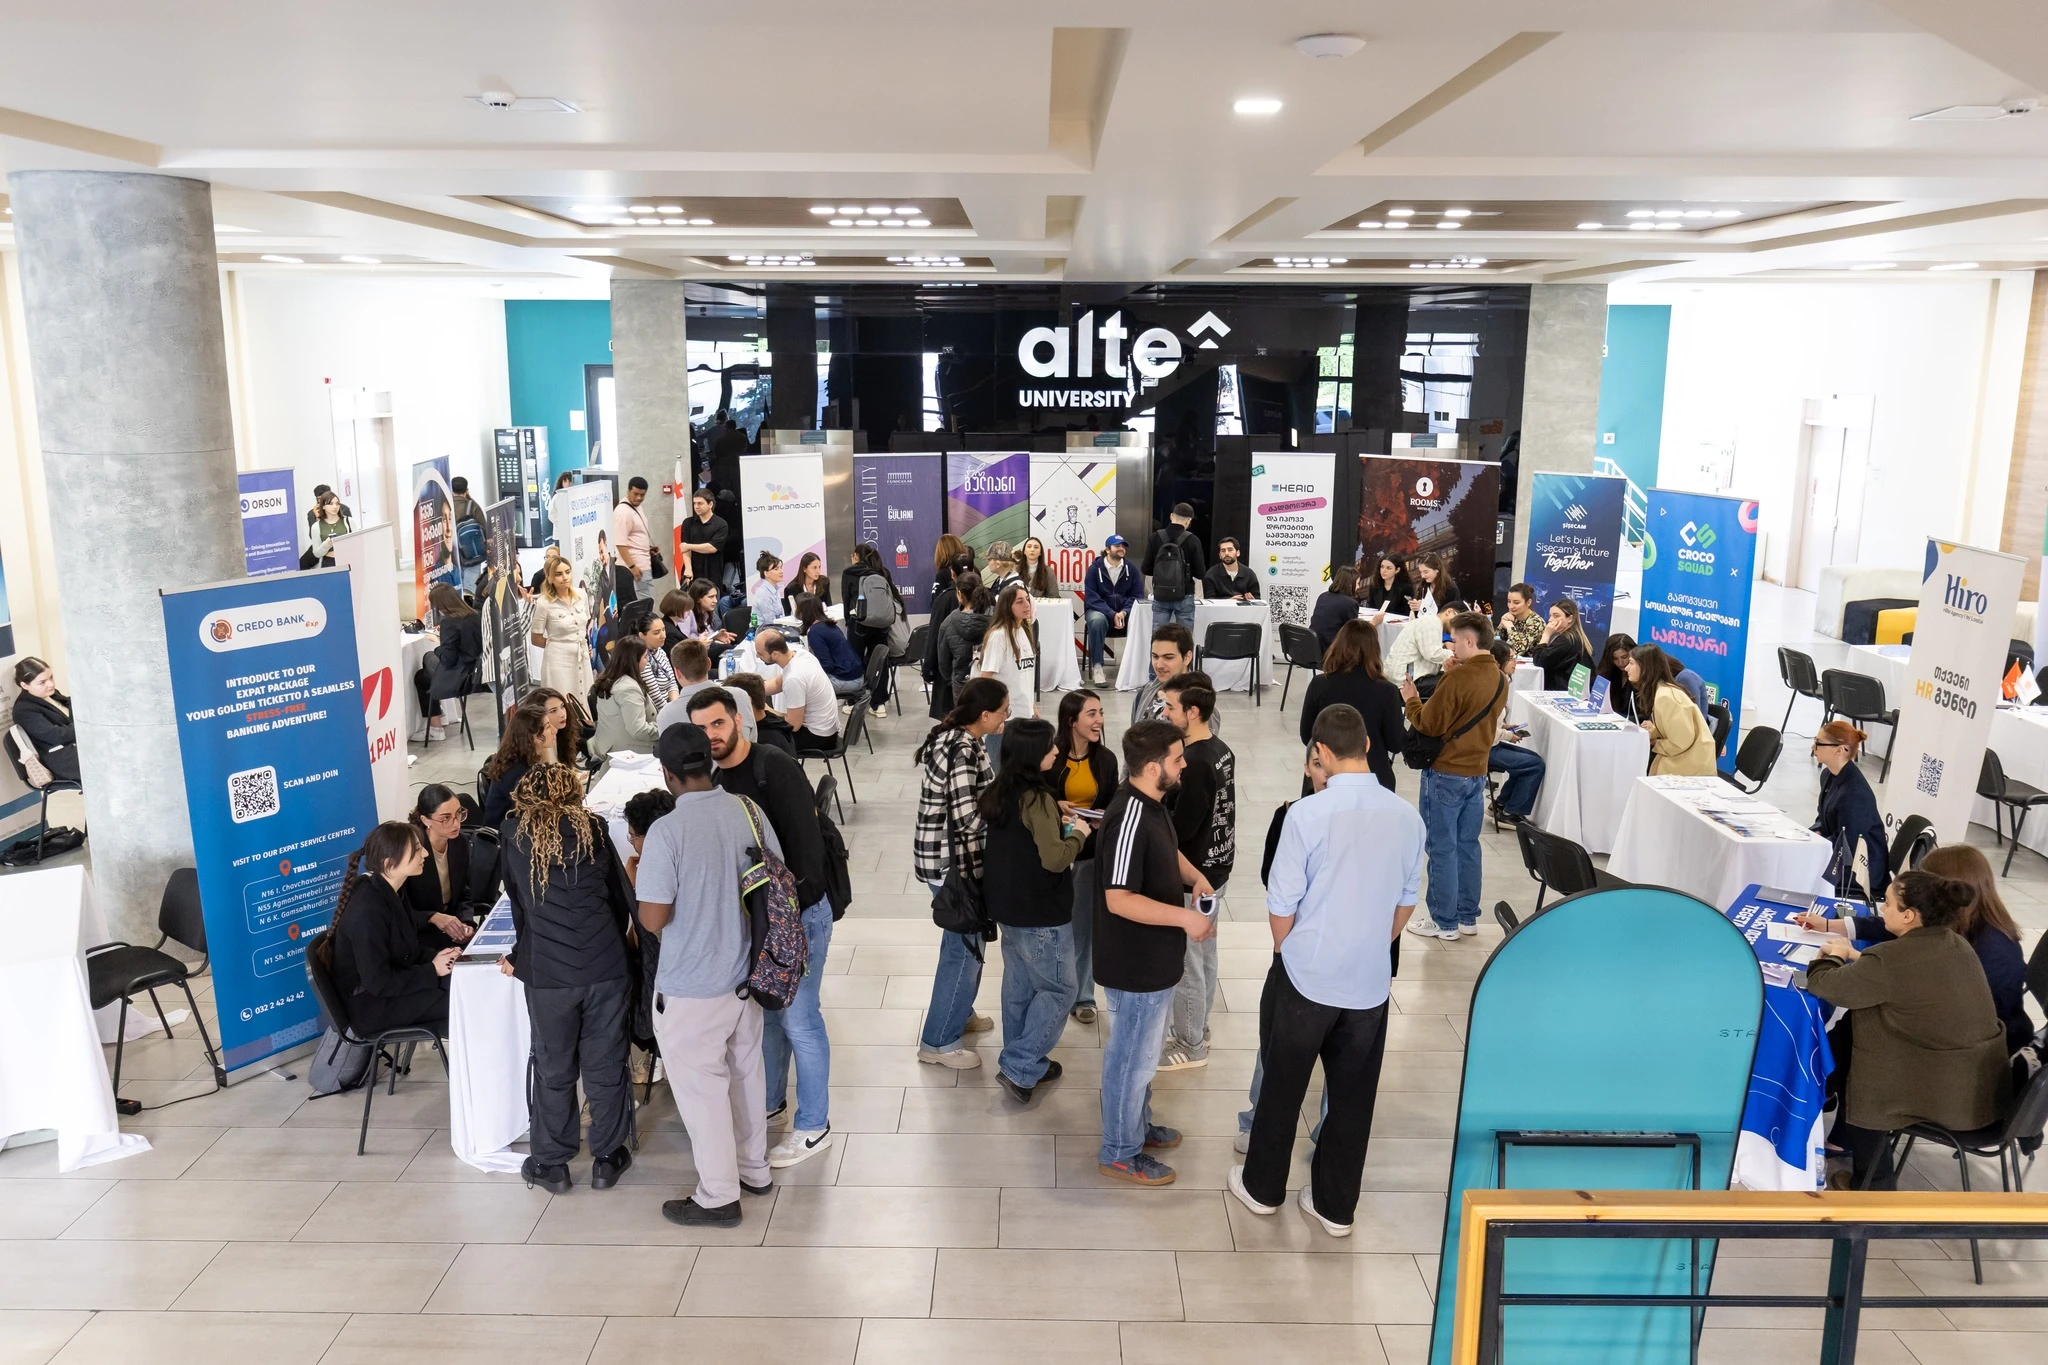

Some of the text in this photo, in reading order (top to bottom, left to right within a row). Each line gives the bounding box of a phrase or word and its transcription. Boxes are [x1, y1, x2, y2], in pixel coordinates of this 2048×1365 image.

[1018, 310, 1182, 378] alte
[1019, 390, 1136, 408] UNIVERSITY
[964, 476, 1016, 492] გულიანი
[1279, 484, 1315, 493] HERIO
[252, 497, 282, 510] ORSON
[861, 465, 879, 551] OSPITALITY
[1268, 500, 1317, 512] გადმოწერე
[1410, 497, 1438, 507] ROOMS
[888, 510, 914, 520] GULIANI
[1265, 532, 1315, 540] სამუშაოები
[1266, 523, 1314, 531] დროებითი
[1549, 533, 1597, 546] Let's build
[1581, 546, 1610, 558] future
[1677, 548, 1715, 563] CROCO
[1541, 551, 1594, 573] Together
[1677, 560, 1714, 576] SQUAD
[1667, 592, 1718, 610] გამოგვყევი
[1944, 573, 1988, 615] Hiro
[1644, 599, 1740, 628] სოციალურ ქსელებში
[236, 619, 274, 633] CREDO
[276, 614, 306, 627] BANK
[1670, 618, 1712, 635] და მიიღე
[1651, 625, 1728, 657] საჩუქარი
[226, 664, 317, 689] INTRODUCE TO OUR
[1934, 665, 1970, 691] თქვენი
[236, 677, 310, 700] EXPAT PACKAGE
[186, 680, 355, 722] YOUR GOLDEN TICKETTO A SEAMLESS
[1915, 678, 1934, 701] HR
[1934, 687, 1978, 720] გუნდი
[245, 703, 307, 723] STRESS-FREE
[226, 710, 328, 740] BANKING ADVENTURE!
[283, 769, 339, 789] SCAN AND JOIN
[232, 826, 356, 867] VISIT TO OUR EXPAT SERVICE CENTRES
[292, 861, 318, 875] TBILISI
[261, 889, 275, 898] N16
[282, 872, 329, 892] Chavchavadze
[329, 868, 341, 878] Ave
[257, 881, 344, 913] N55 Agmashenebeli Avenu
[266, 914, 272, 923] 6
[301, 924, 328, 938] BATUMI
[264, 956, 273, 966] N1
[255, 990, 305, 1015] 032 2 42 42 42
